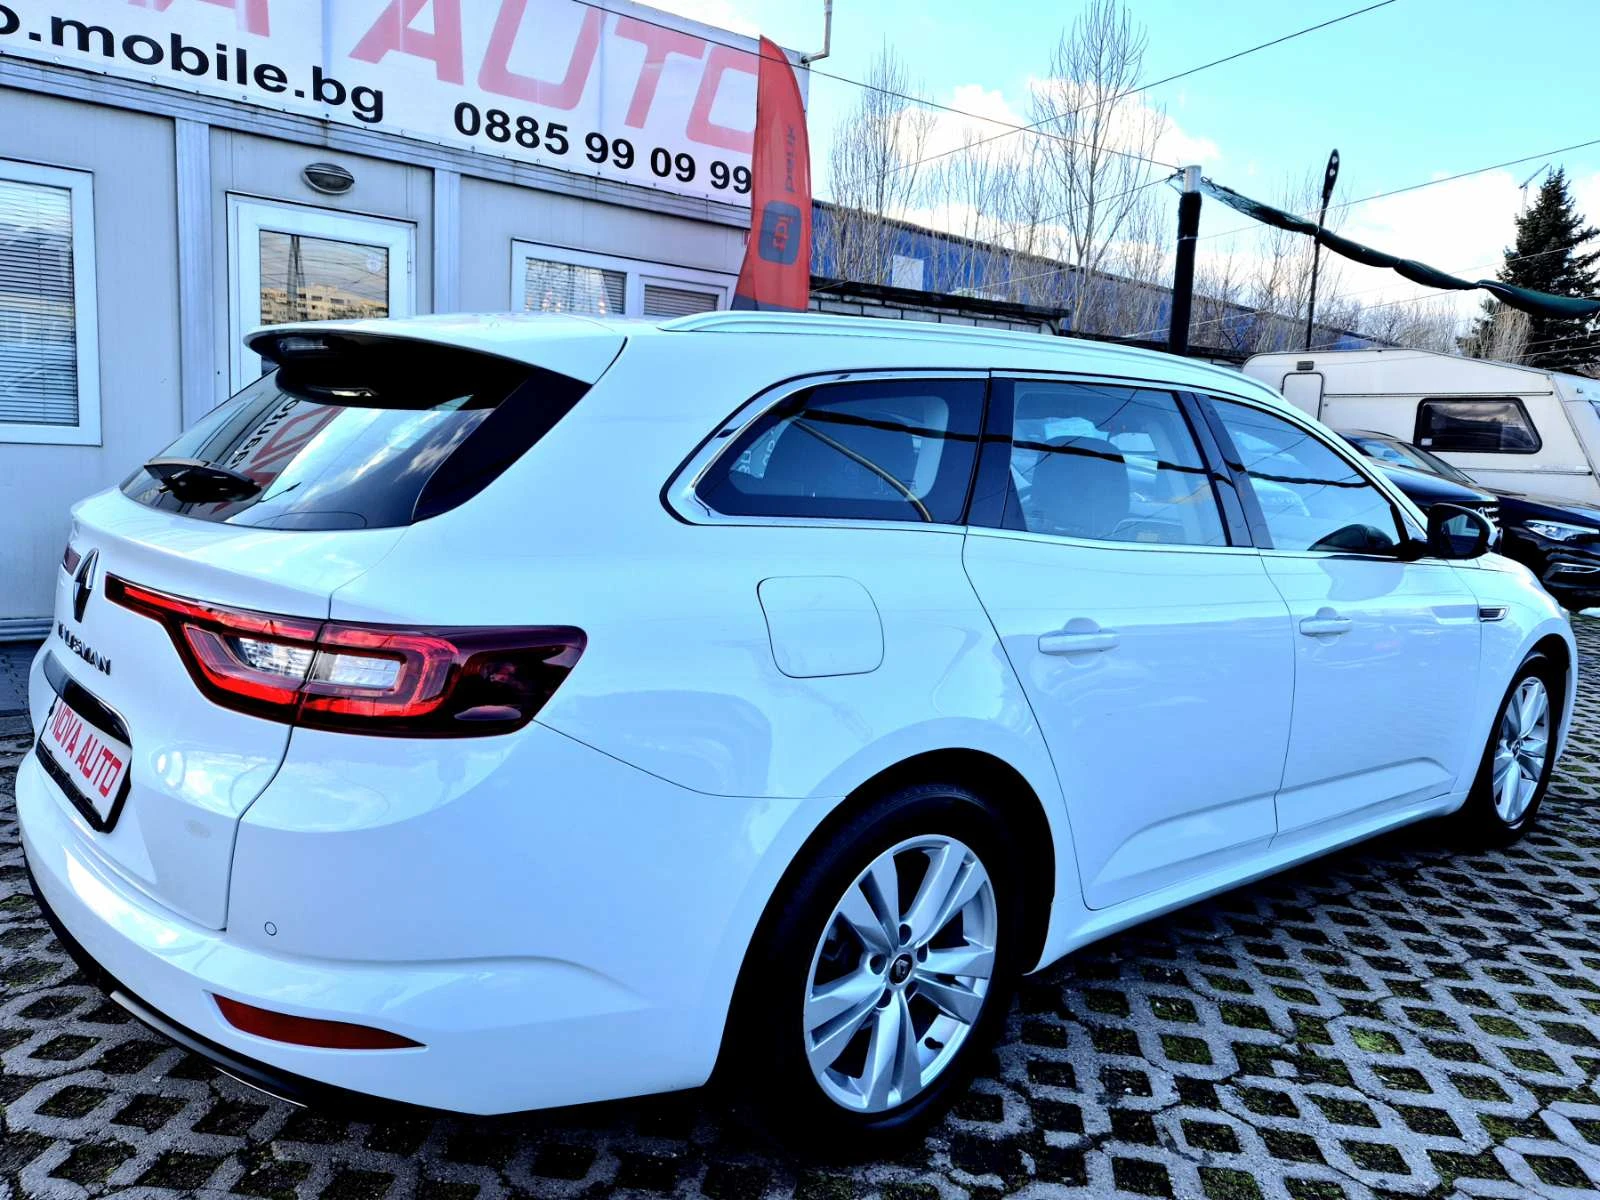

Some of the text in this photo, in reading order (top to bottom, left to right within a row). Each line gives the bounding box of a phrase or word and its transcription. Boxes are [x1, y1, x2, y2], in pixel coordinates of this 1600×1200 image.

[454, 102, 752, 194] 0885 99 09 99
[49, 700, 122, 797] NOVA AUTO
